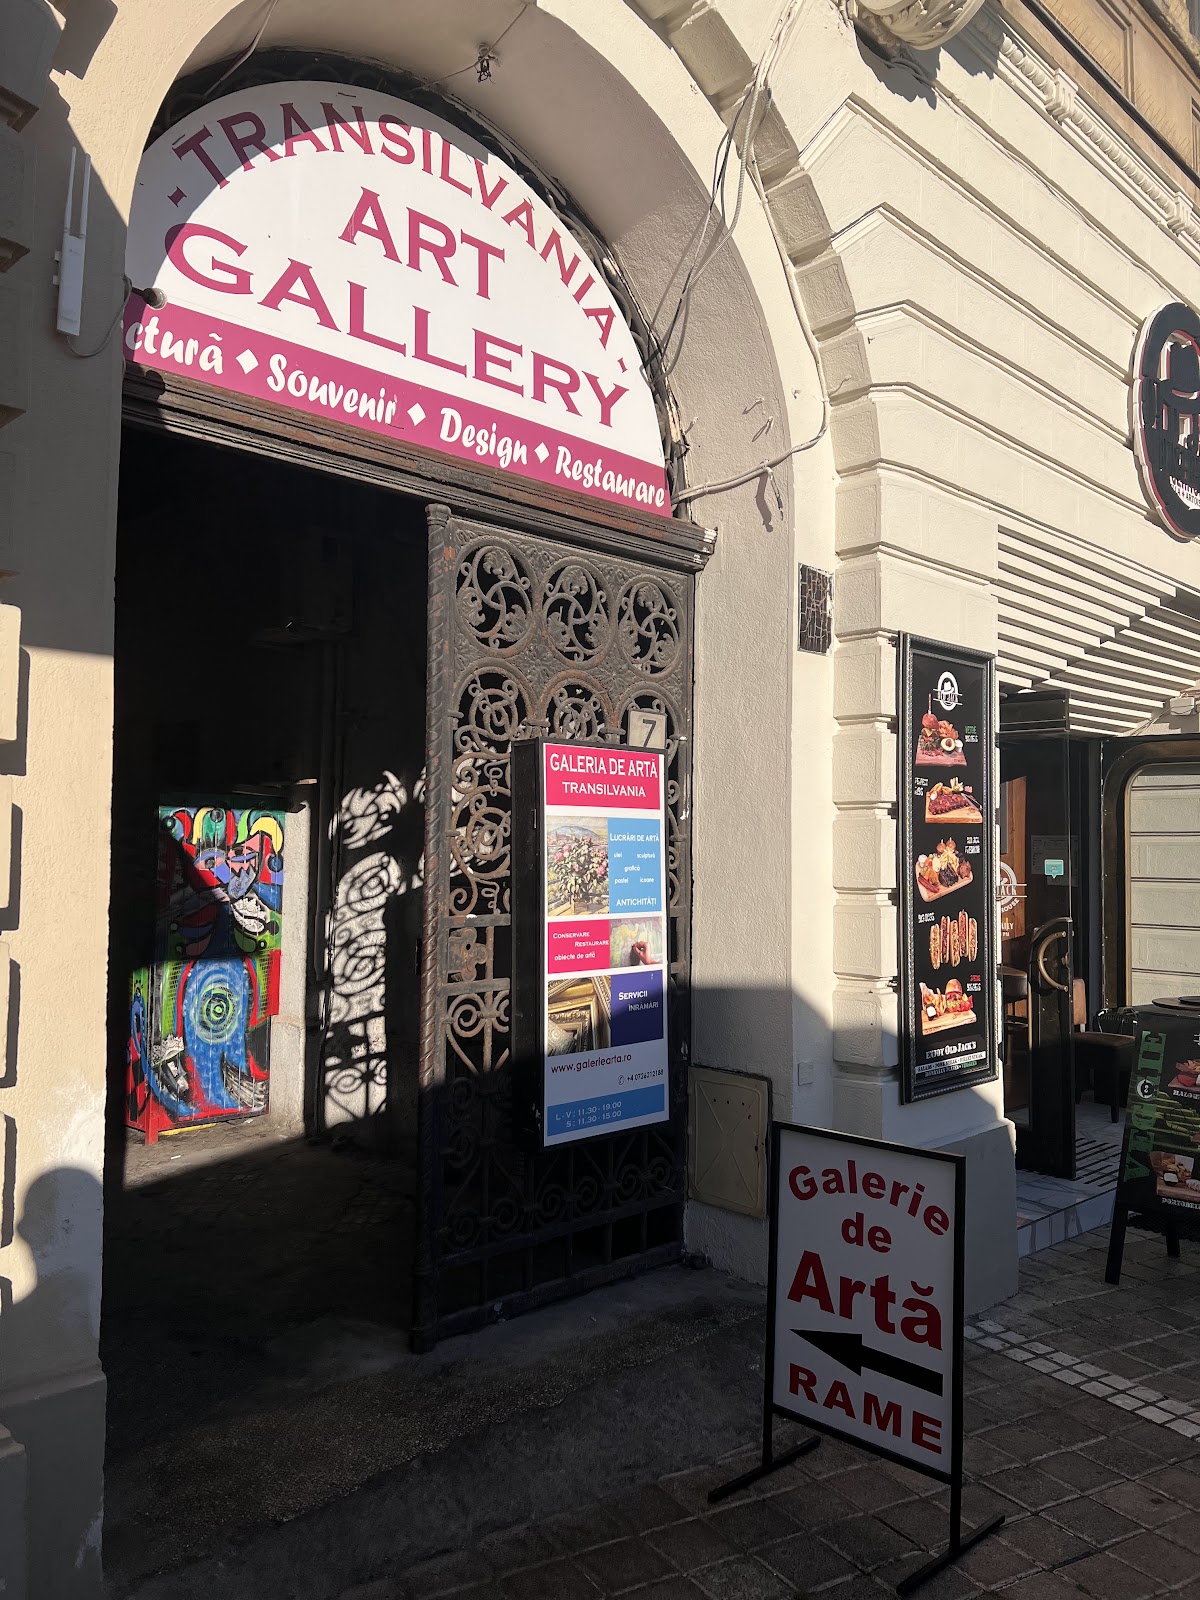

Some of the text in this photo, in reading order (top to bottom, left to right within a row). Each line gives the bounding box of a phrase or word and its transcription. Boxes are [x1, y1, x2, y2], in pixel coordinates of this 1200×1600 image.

[174, 101, 622, 349] TRANSILVANIA
[338, 186, 505, 300] ART
[164, 222, 630, 428] GALLERY
[267, 353, 398, 426] Souvenir
[439, 407, 528, 468] Design
[555, 445, 666, 508] Restaurare
[642, 718, 657, 747] 7
[549, 752, 658, 779] GALERIA DE ARTĂ
[562, 781, 646, 798] TRANSILVANIA
[637, 834, 645, 842] DE
[614, 877, 629, 885] pastel
[552, 931, 591, 940] CONSERVARE
[574, 939, 610, 948] RESTAURARE
[554, 953, 576, 961] obiecte
[618, 990, 648, 1001] SERVICII
[925, 1047, 945, 1060] ENJOY
[945, 1044, 958, 1056] OLD
[550, 1054, 633, 1074] www.galeriearta.ro
[555, 1113, 562, 1121] L
[577, 1106, 598, 1116] 11.30
[602, 1101, 622, 1111] 19.00
[577, 1115, 598, 1125] 11.30
[602, 1110, 622, 1120] 15.00
[788, 1159, 950, 1236] Galerie
[841, 1211, 893, 1254] de
[787, 1249, 943, 1351] Artă
[788, 1362, 943, 1455] RAME
